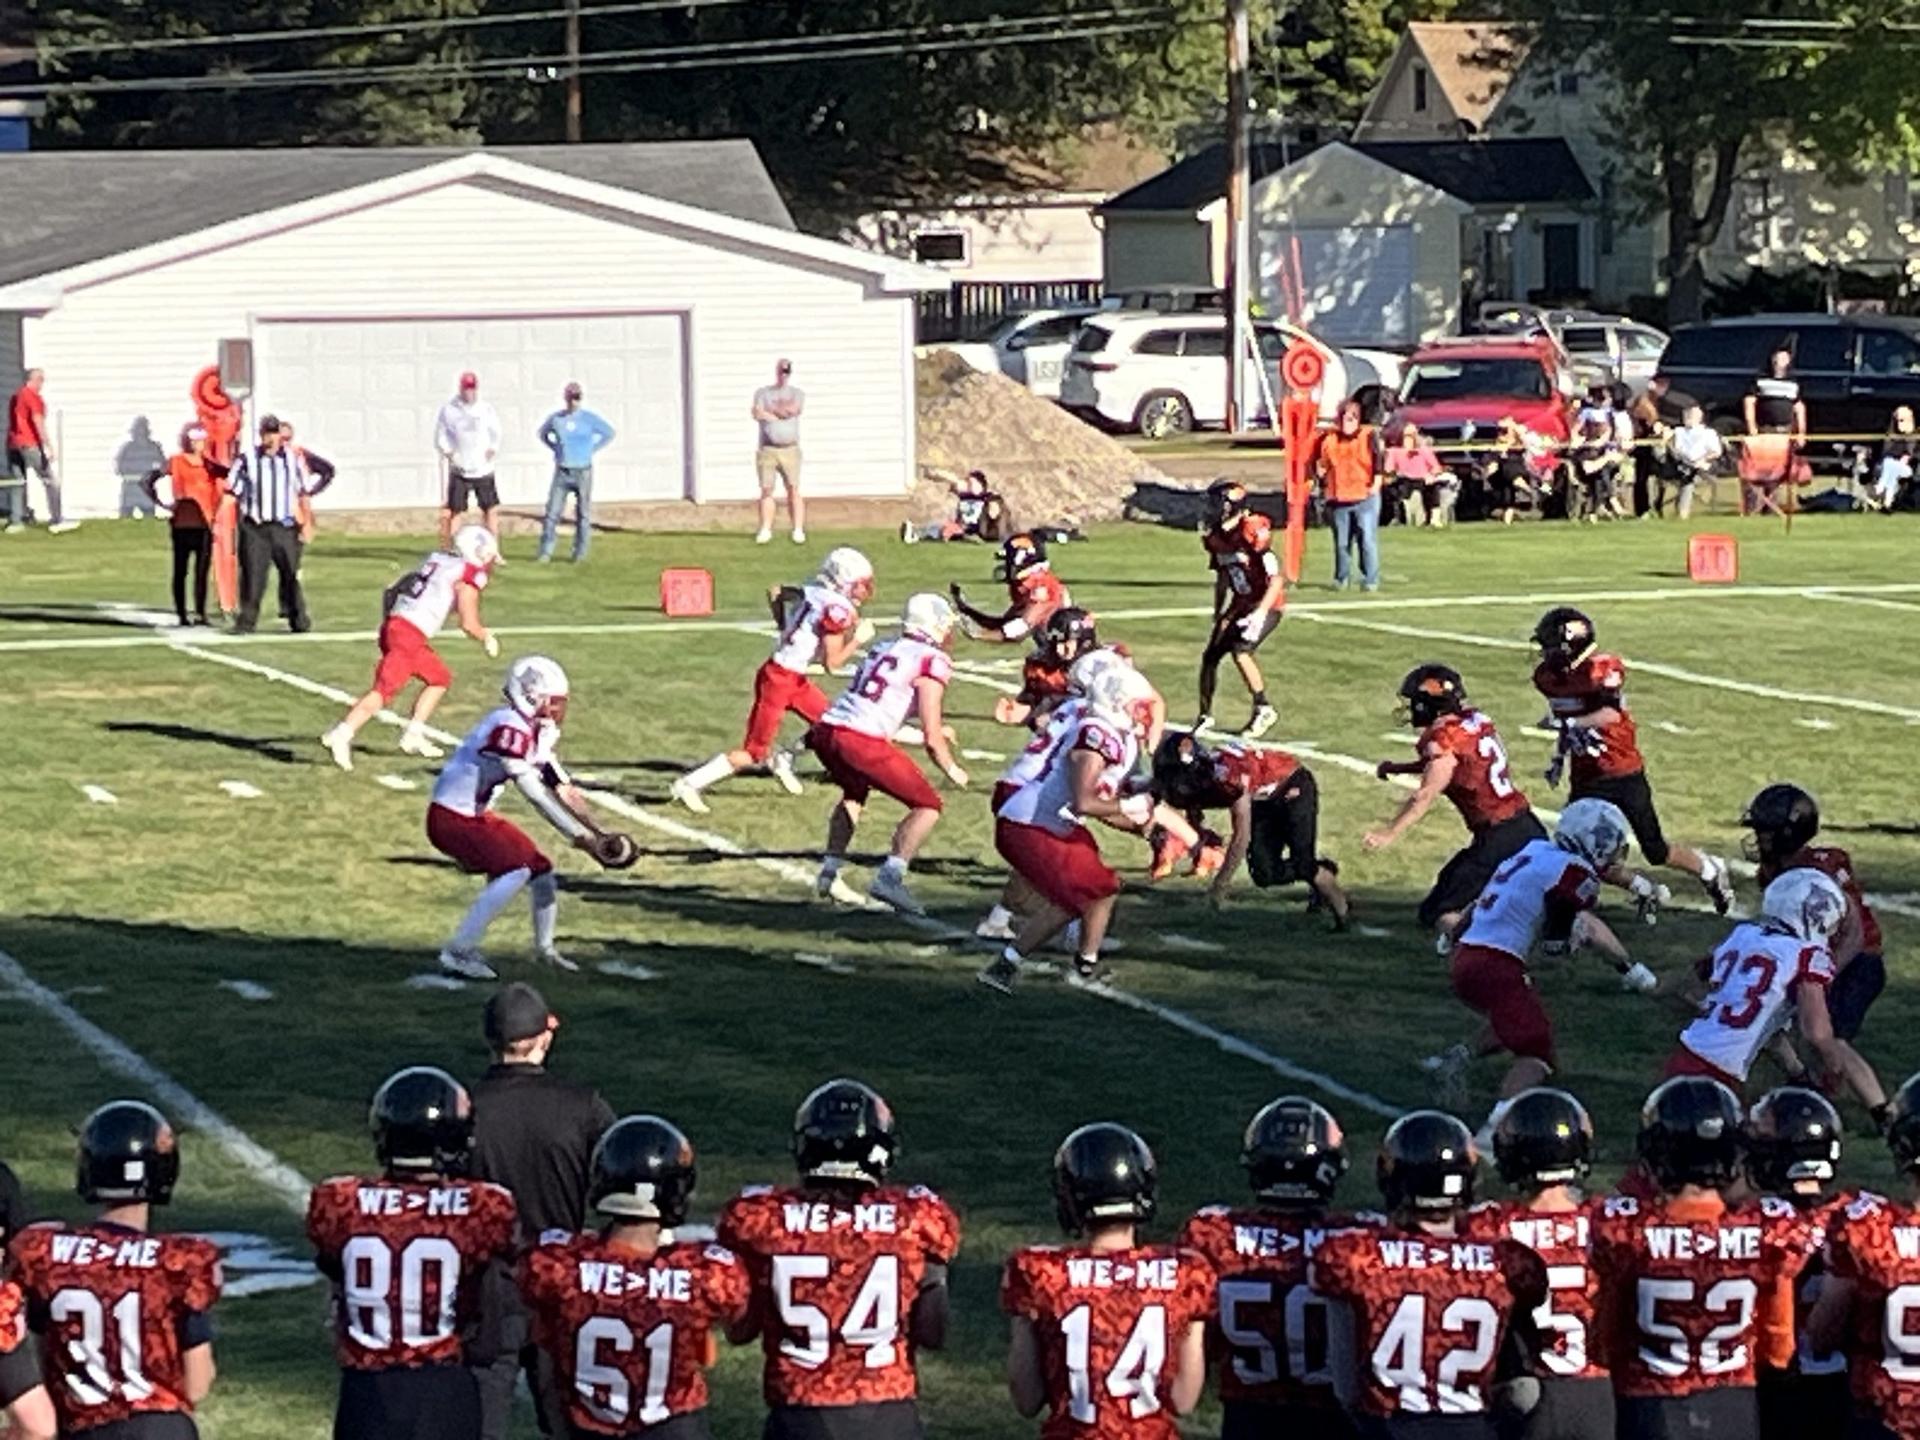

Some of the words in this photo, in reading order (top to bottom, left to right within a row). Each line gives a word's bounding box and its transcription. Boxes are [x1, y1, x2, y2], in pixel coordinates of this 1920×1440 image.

[357, 1186, 471, 1215] WE>ME
[784, 1203, 898, 1234] WE>ME
[51, 1235, 161, 1268] WE>ME
[1234, 1225, 1326, 1257] WE>M
[1380, 1240, 1495, 1272] WE>ME
[1644, 1226, 1761, 1259] WE>ME
[342, 1236, 460, 1350] 80
[579, 1262, 691, 1301] WE>ME
[1067, 1258, 1178, 1289] WE>ME
[771, 1255, 899, 1369] 54
[1636, 1278, 1758, 1376] 52
[50, 1288, 153, 1405] 31
[1061, 1305, 1167, 1424] 14
[1372, 1294, 1498, 1413] 42
[575, 1316, 673, 1424] 61
